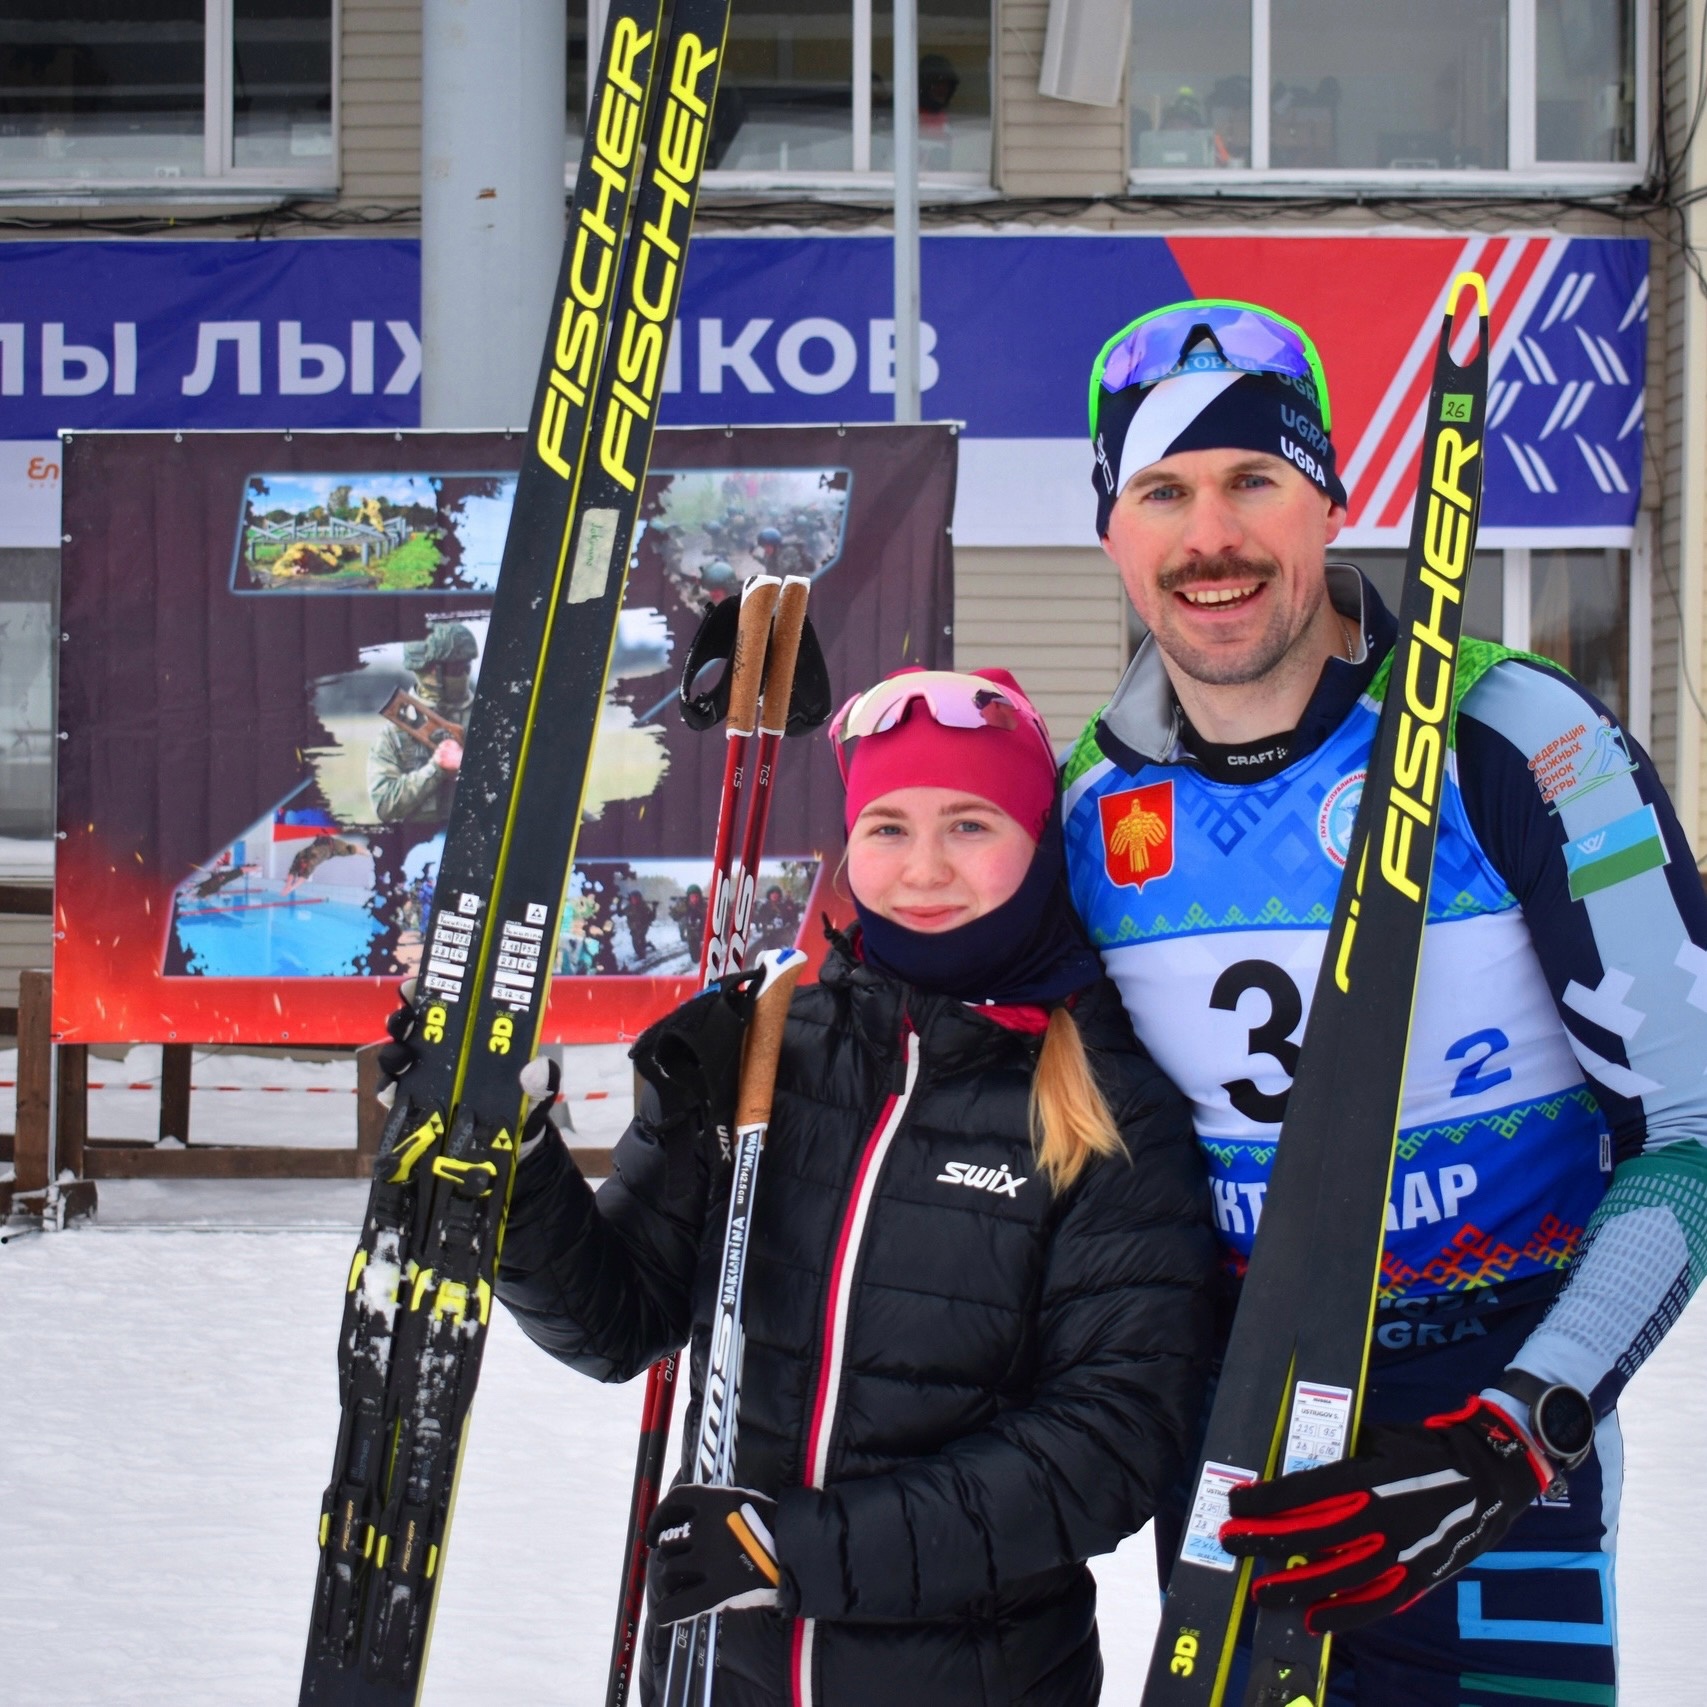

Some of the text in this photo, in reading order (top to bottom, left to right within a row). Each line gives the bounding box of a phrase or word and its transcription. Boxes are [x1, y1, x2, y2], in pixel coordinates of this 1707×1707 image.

[537, 17, 653, 480] FISCHER
[600, 32, 718, 492] FISCHER
[1445, 400, 1465, 418] 26
[1280, 403, 1330, 457] UGRA
[1280, 436, 1327, 487] UGRA
[1380, 427, 1479, 902] FISCHER
[1227, 750, 1274, 766] CRAFT
[1527, 723, 1587, 771] ФЕДЕРАЦИЯ
[1534, 742, 1583, 783] ЛЫЖНЫХ
[733, 766, 744, 789] TCS
[759, 763, 771, 787] TCS
[1538, 762, 1574, 793] ГОНОК
[1541, 776, 1577, 804] ЮГРЫ
[423, 1006, 447, 1044] 3D
[488, 1017, 514, 1055] 3D
[1444, 1028, 1512, 1098] 2
[1301, 1408, 1333, 1418] USTIUGOV
[341, 1499, 355, 1552] FISCHER
[402, 1519, 416, 1573] FISCHER
[677, 1626, 689, 1649] 30
[1179, 1626, 1201, 1638] GLIDE
[1170, 1634, 1198, 1677] 3D
